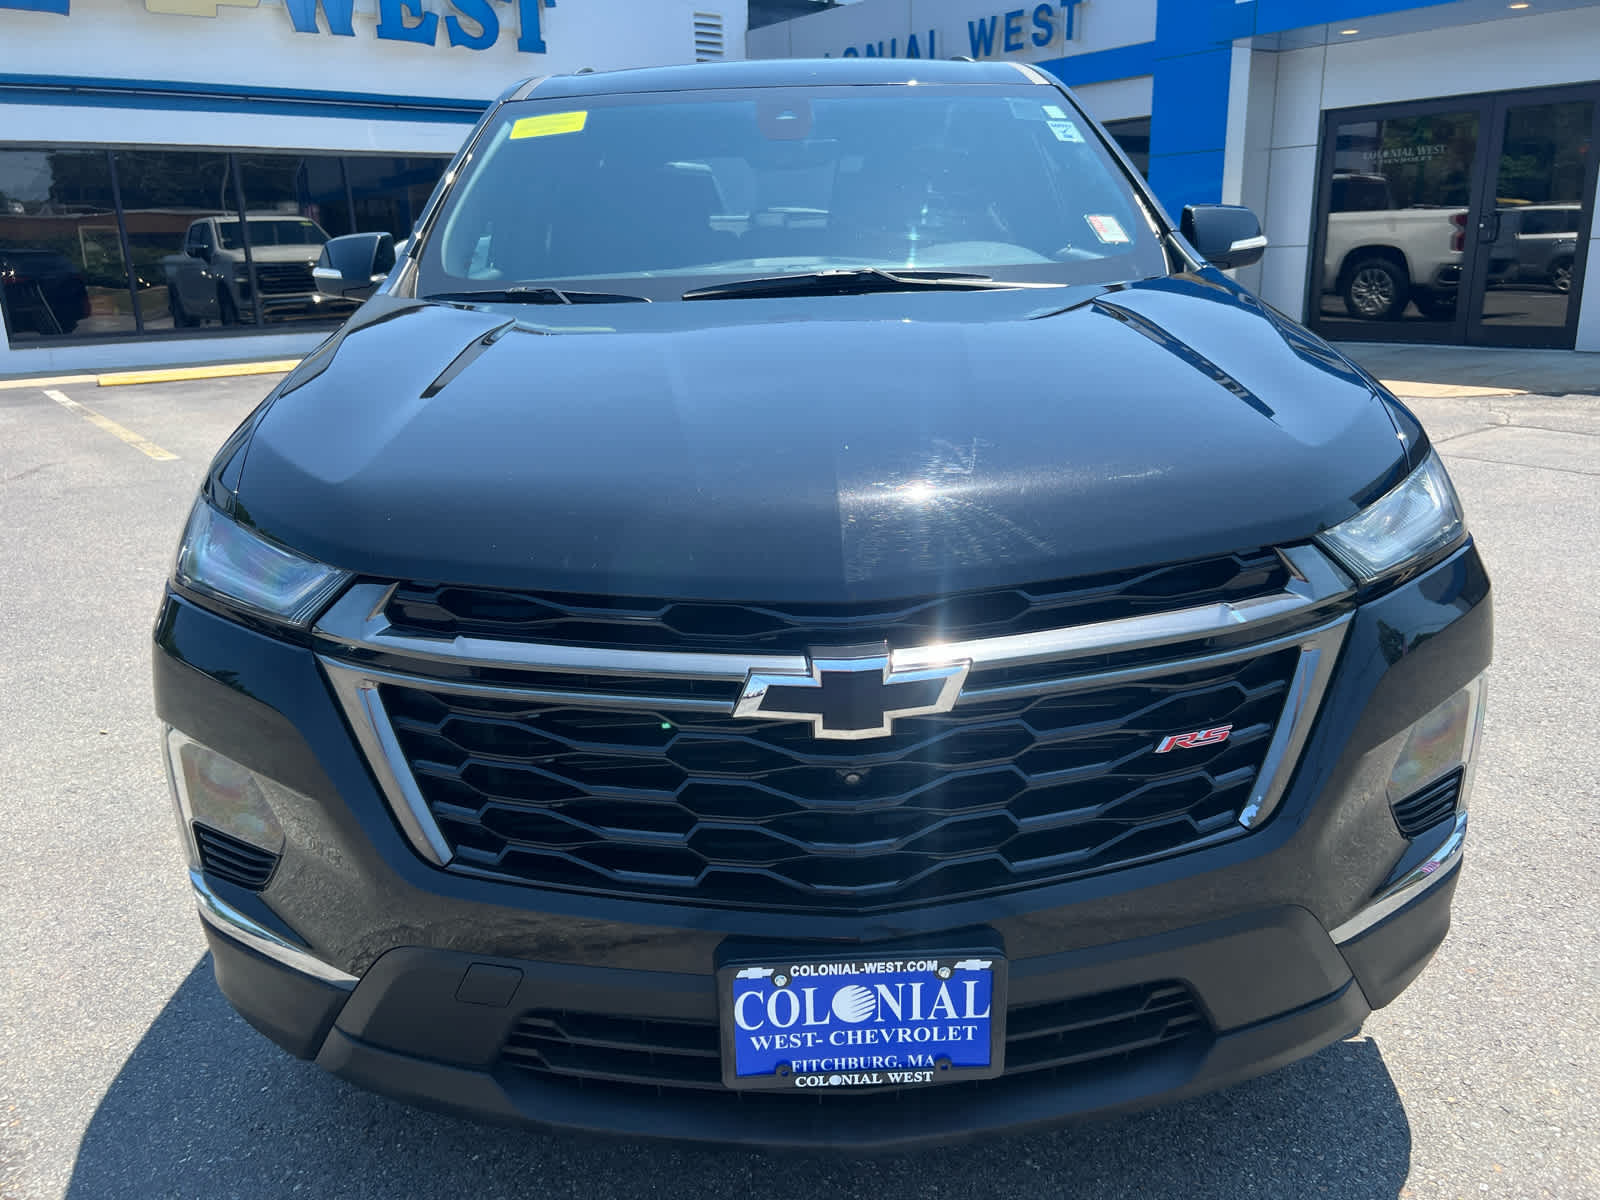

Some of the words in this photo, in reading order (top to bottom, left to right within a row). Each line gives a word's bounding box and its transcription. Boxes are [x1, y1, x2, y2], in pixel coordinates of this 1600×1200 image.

[968, 0, 1083, 58] WEST
[1417, 144, 1448, 156] WEST
[1154, 724, 1233, 754] RS
[790, 960, 938, 977] COLONIAL-WEST.COM
[733, 980, 991, 1031] COLONIAL
[829, 1025, 978, 1046] CHEVROLET
[907, 1054, 935, 1068] MA
[795, 1073, 882, 1088] COLONIAL
[890, 1070, 934, 1083] WEST
